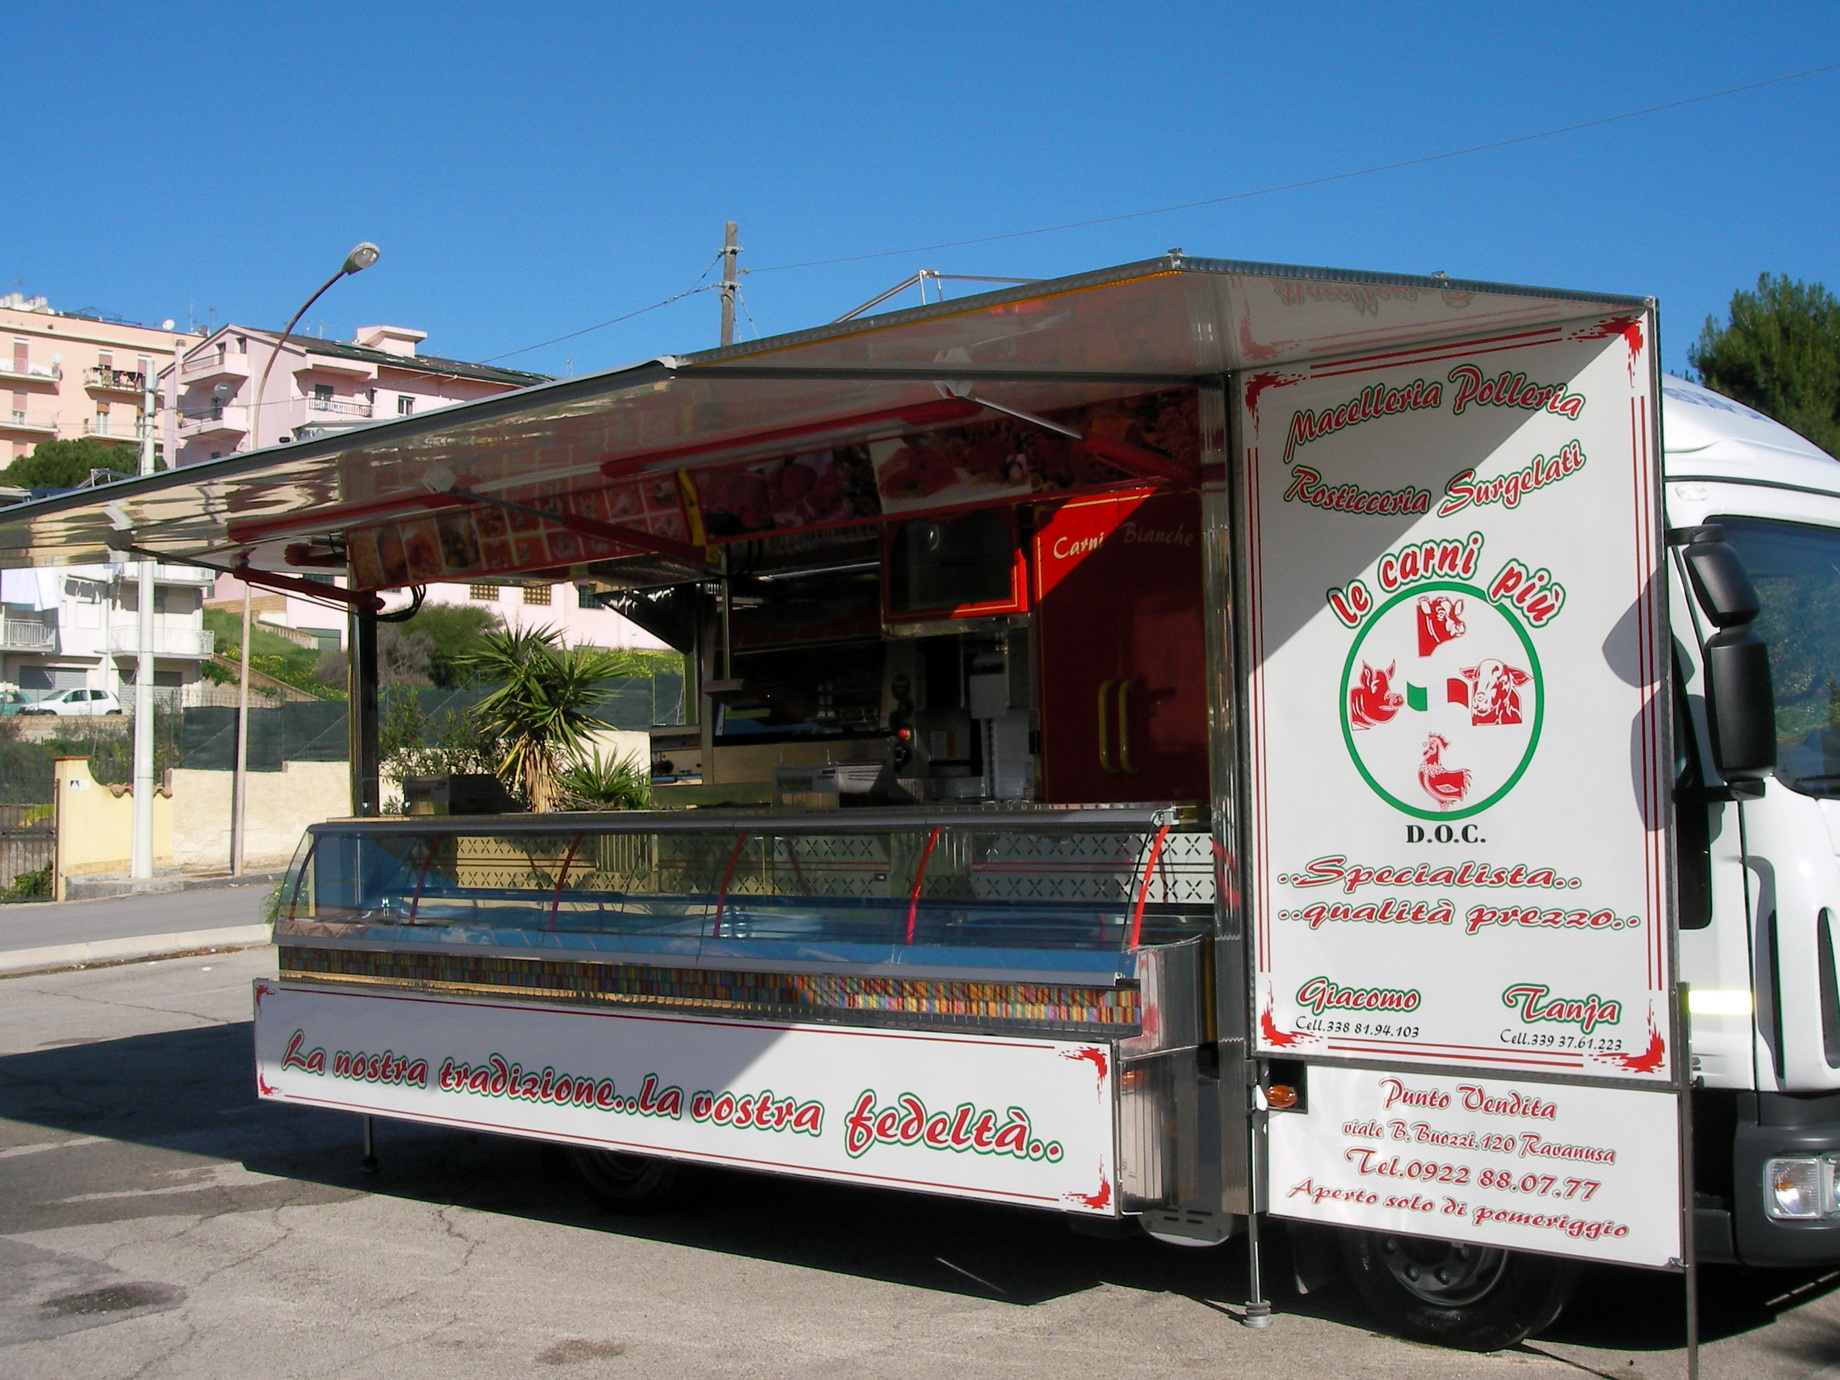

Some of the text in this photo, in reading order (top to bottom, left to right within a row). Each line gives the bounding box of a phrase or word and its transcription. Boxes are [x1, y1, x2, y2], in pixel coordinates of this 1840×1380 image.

[1284, 378, 1442, 462] Macelleria
[1448, 364, 1586, 420] Polleria
[1284, 439, 1587, 518] Rosticceria Surgelati
[1053, 521, 1195, 559] Carni Bianche
[1328, 531, 1566, 629] le carni più
[1406, 824, 1487, 844] D.O.C.
[1296, 976, 1422, 1016] Giacomo
[1502, 983, 1623, 1035] Tanja
[281, 1029, 326, 1076] La
[333, 1049, 429, 1089] nostra
[690, 1089, 824, 1137] vostra
[1379, 1077, 1558, 1121] Punto Vendita
[1342, 1119, 1384, 1139] viale
[1518, 1131, 1616, 1166] Ravanusa
[1286, 1176, 1631, 1241] Aperto solo di pomeriggio
[1477, 1167, 1601, 1201] 88.07.77
